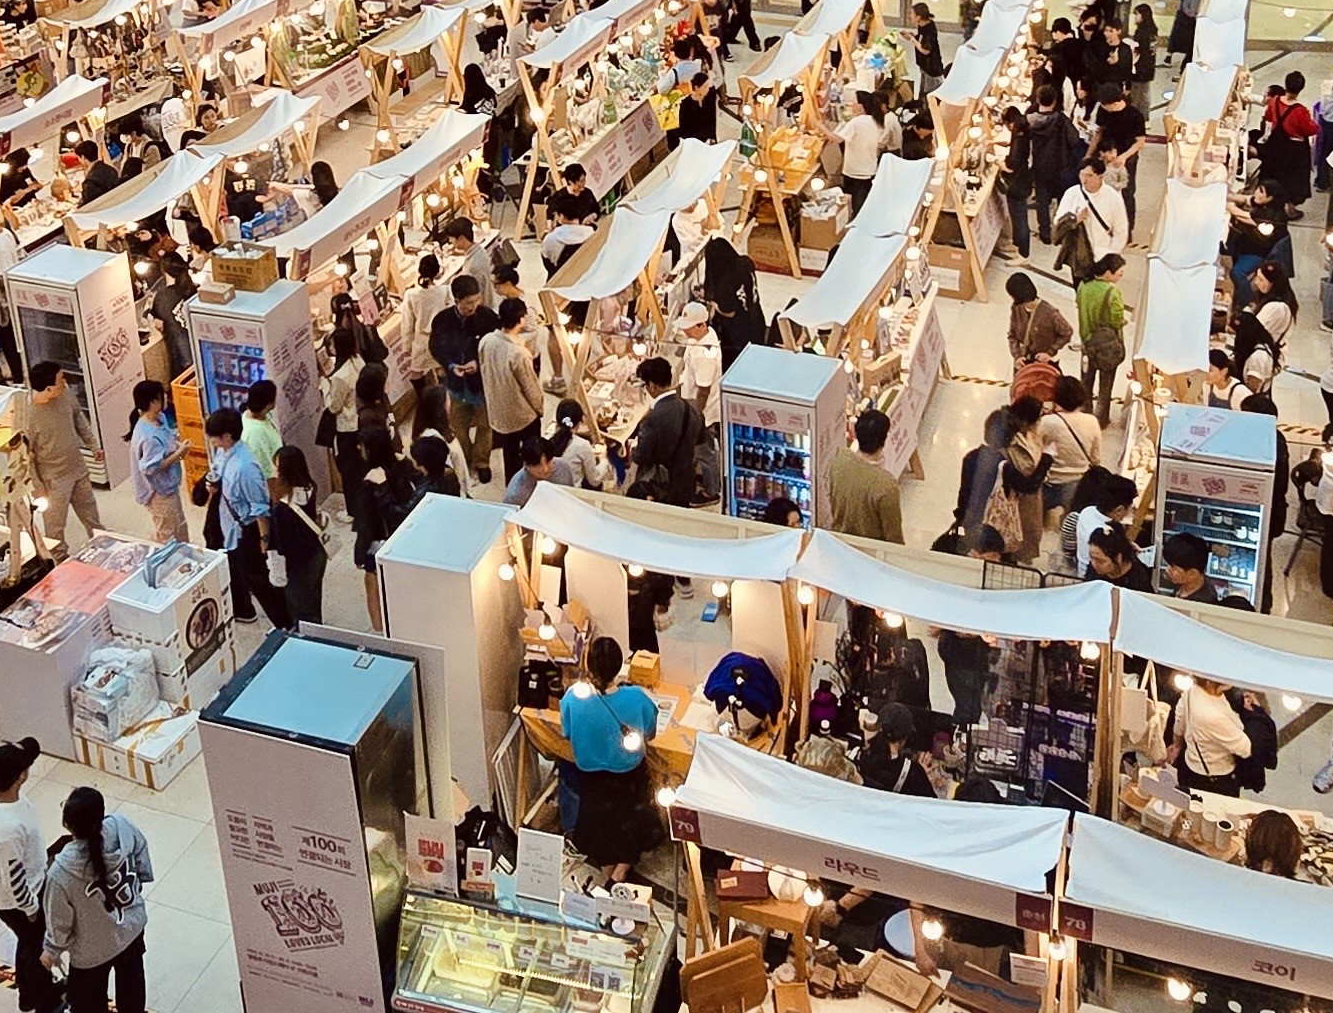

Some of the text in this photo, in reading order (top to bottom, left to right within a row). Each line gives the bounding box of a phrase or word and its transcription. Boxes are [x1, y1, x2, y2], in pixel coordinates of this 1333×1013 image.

[823, 856, 882, 883] 라우드
[253, 880, 279, 896] MUJI
[1064, 917, 1087, 931] 78
[284, 935, 311, 948] LOVES
[1251, 957, 1298, 982] 코이
